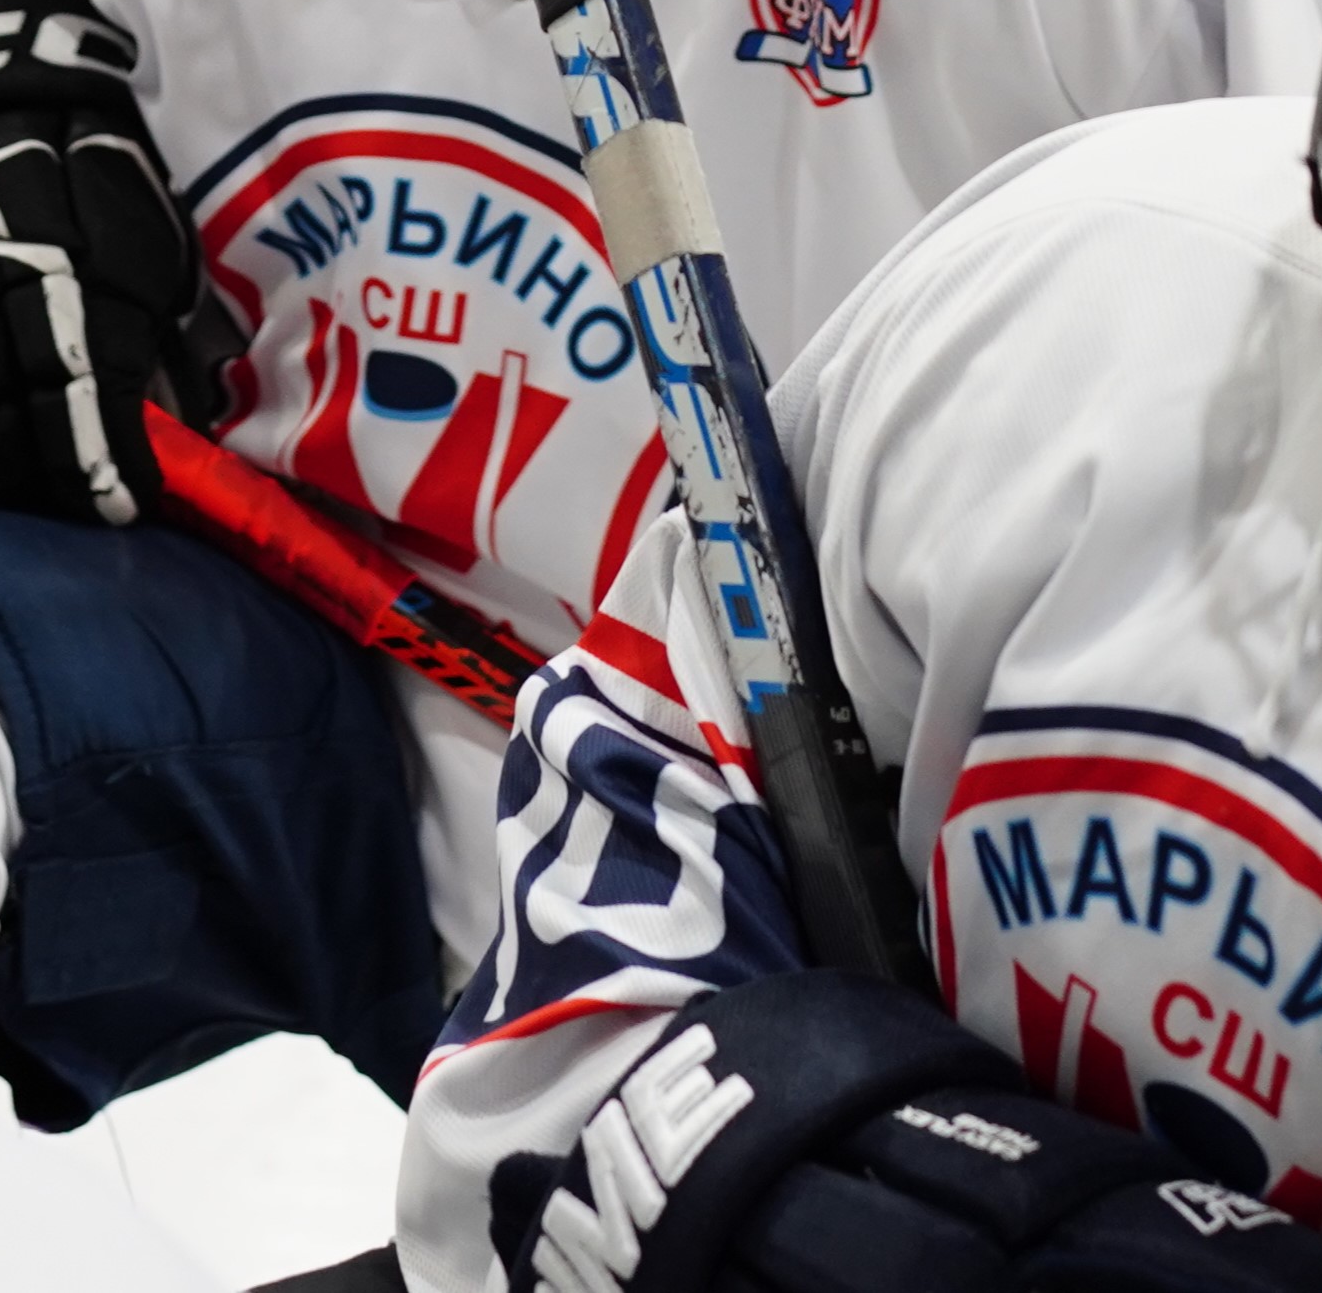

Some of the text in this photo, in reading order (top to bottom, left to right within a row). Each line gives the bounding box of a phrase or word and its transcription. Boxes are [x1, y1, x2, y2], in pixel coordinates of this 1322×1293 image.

[254, 175, 636, 383] МАРЬИНО
[360, 276, 469, 346] СШ
[1151, 981, 1293, 1121] СШ
